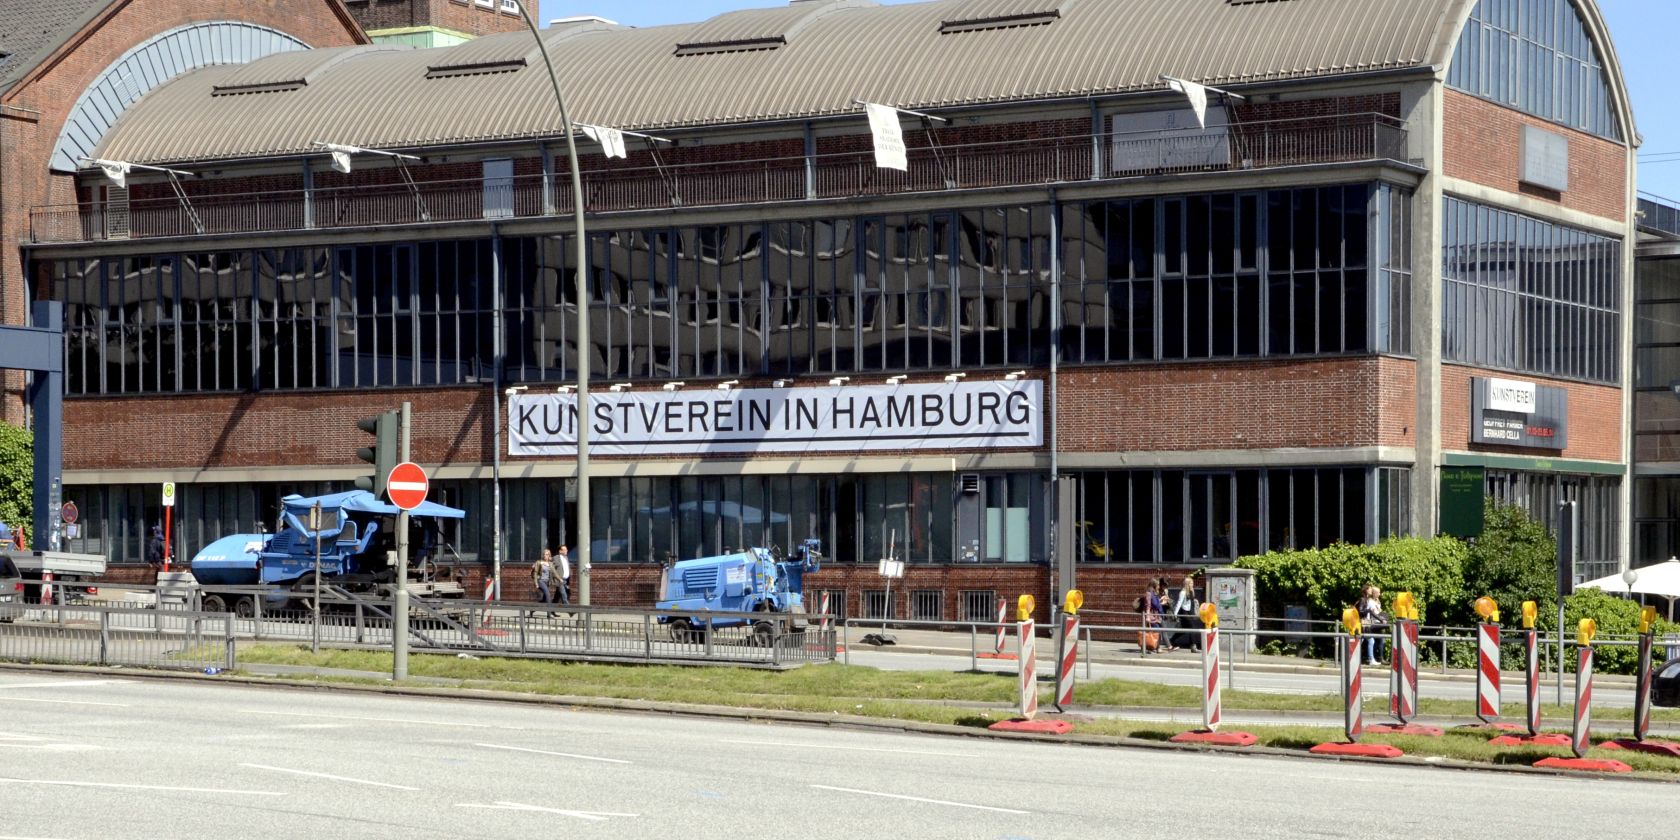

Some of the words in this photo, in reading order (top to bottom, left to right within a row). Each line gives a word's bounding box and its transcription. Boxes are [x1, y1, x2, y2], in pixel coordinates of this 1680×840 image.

[1492, 387, 1535, 404] KUNSTVEREIN
[519, 398, 771, 435] KUNSTVEREIN
[785, 397, 818, 430] IN
[832, 390, 1030, 429] HAMBURG
[1506, 430, 1520, 440] CELLA
[308, 561, 336, 569] DMAG
